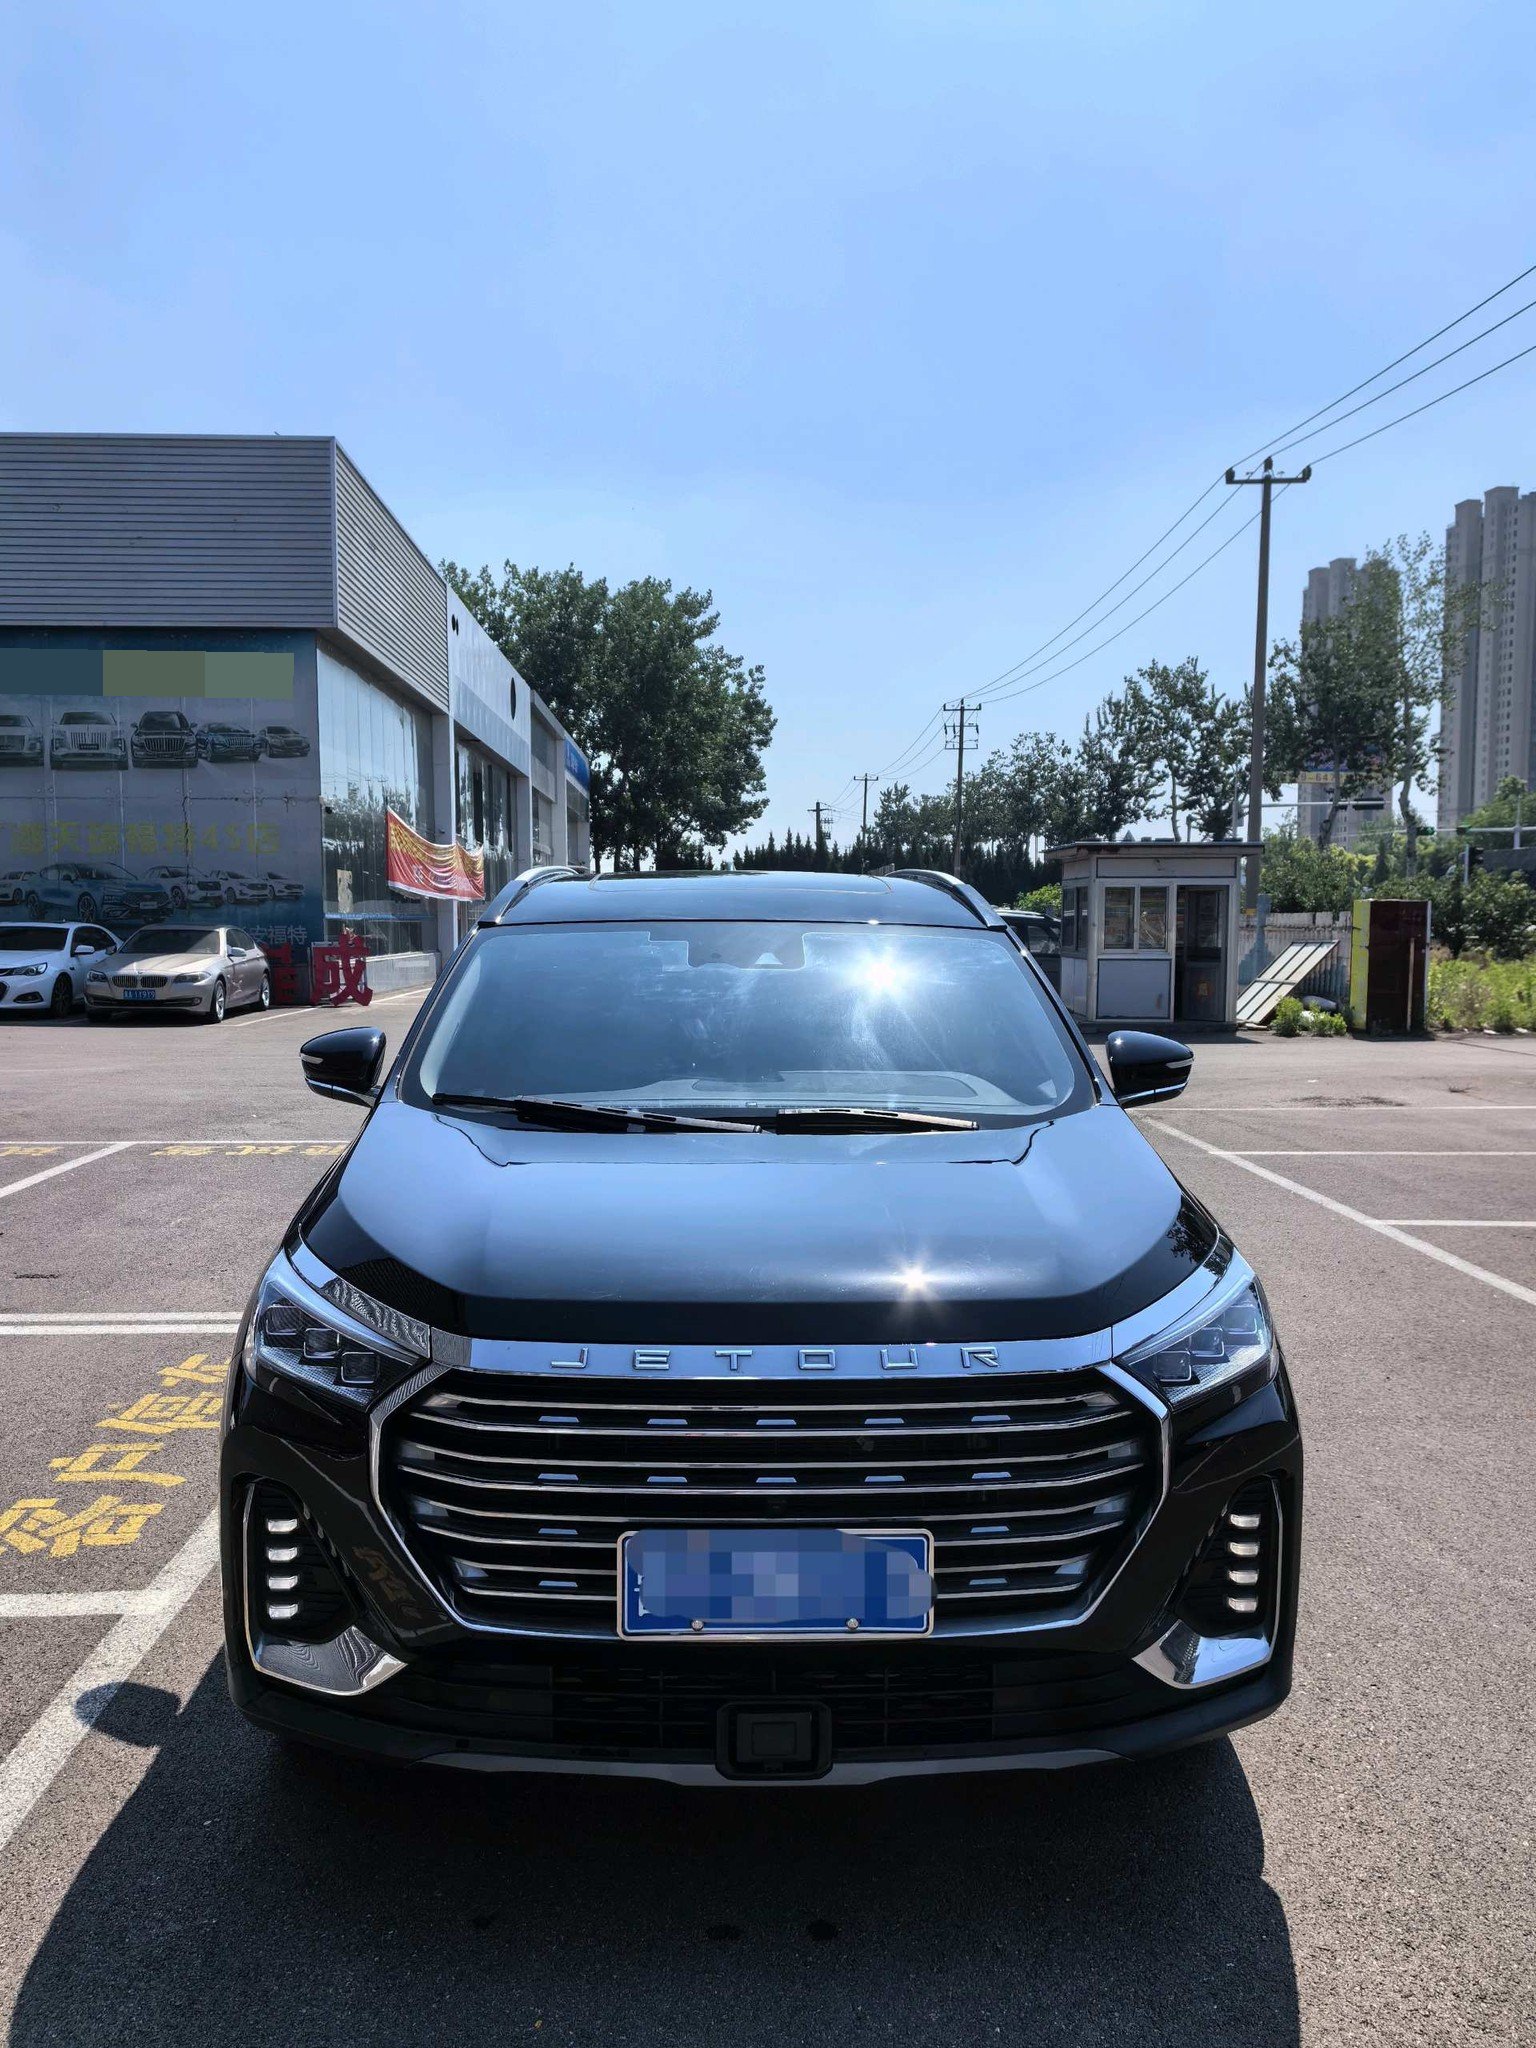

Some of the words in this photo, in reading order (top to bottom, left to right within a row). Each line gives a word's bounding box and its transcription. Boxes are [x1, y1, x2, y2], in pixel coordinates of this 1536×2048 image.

[247, 924, 307, 945] 安福特
[550, 1346, 999, 1370] JETOUR
